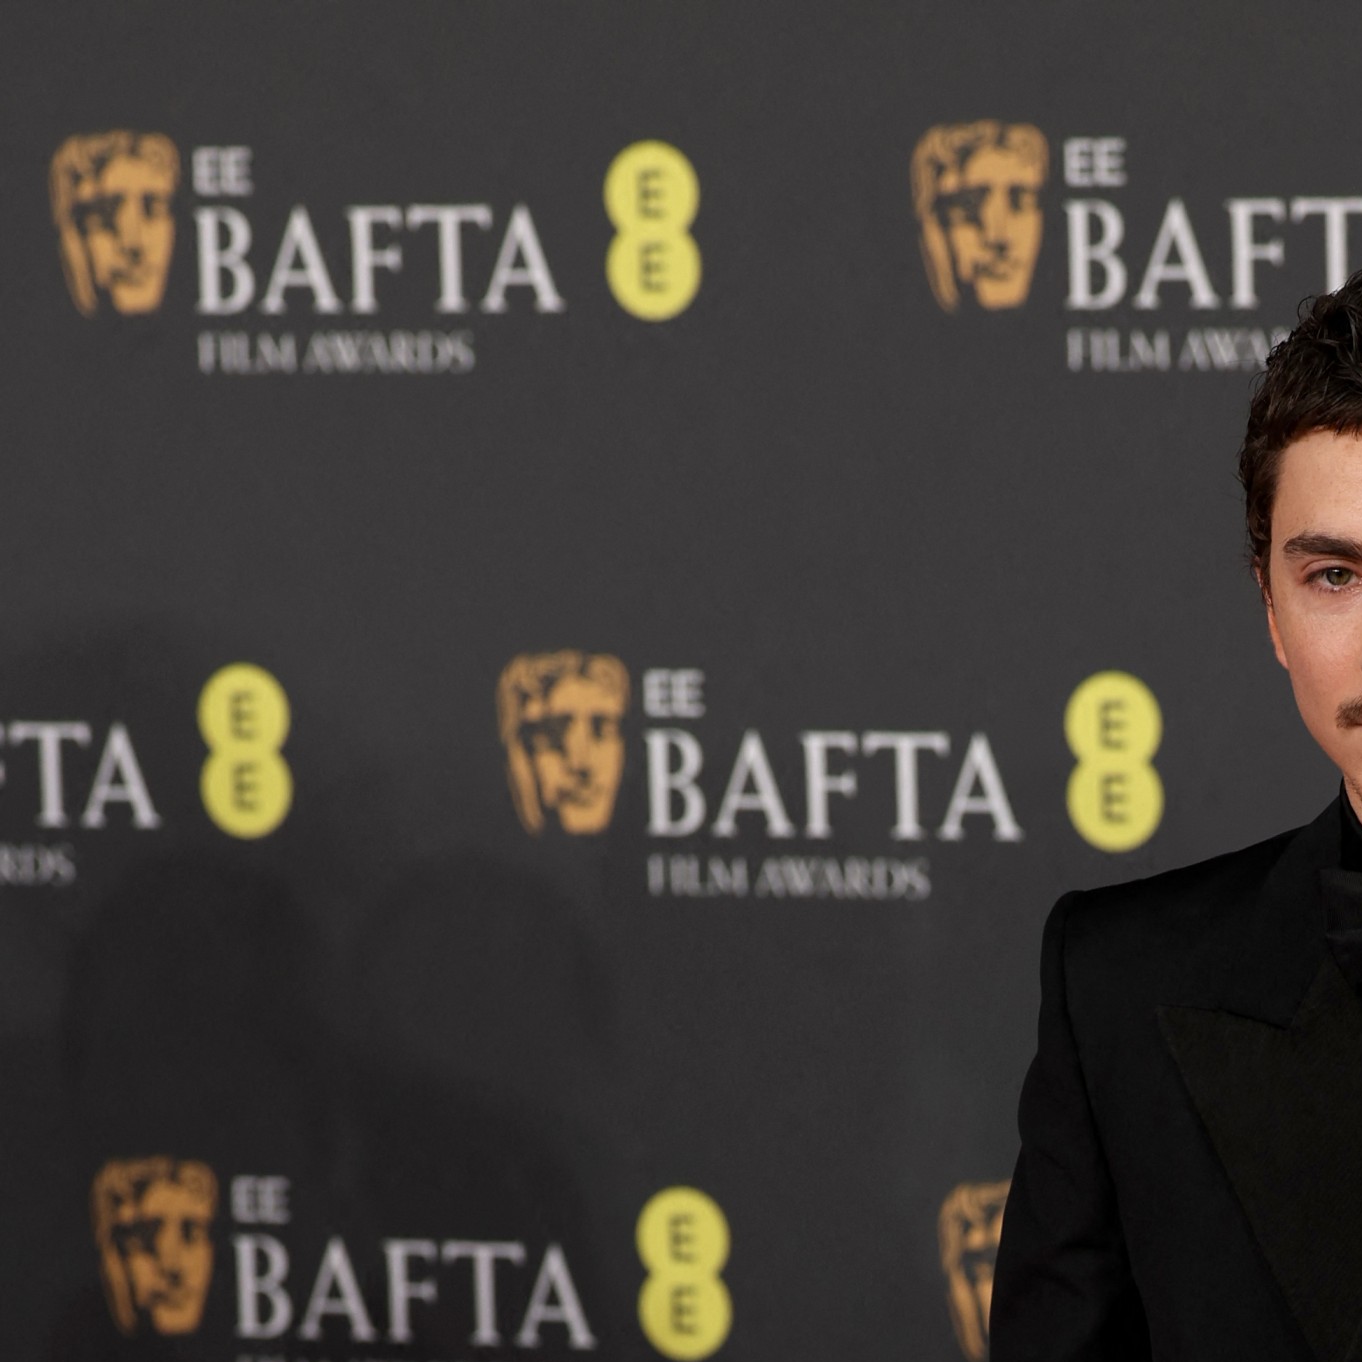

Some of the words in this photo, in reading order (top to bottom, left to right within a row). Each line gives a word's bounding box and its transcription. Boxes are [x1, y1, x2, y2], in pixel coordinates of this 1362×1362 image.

[191, 146, 253, 197] EE
[1062, 137, 1127, 187] EE
[194, 204, 564, 315] BAFTA
[196, 332, 298, 373] FILM
[305, 332, 476, 371] AWARDS
[1065, 329, 1172, 371] FILM
[641, 668, 706, 718] EE
[644, 729, 1022, 841] BAFTA
[646, 854, 750, 896] FILM
[756, 857, 932, 898] AWARDS
[229, 1175, 290, 1225] EE
[233, 1234, 596, 1350] BAFTA
